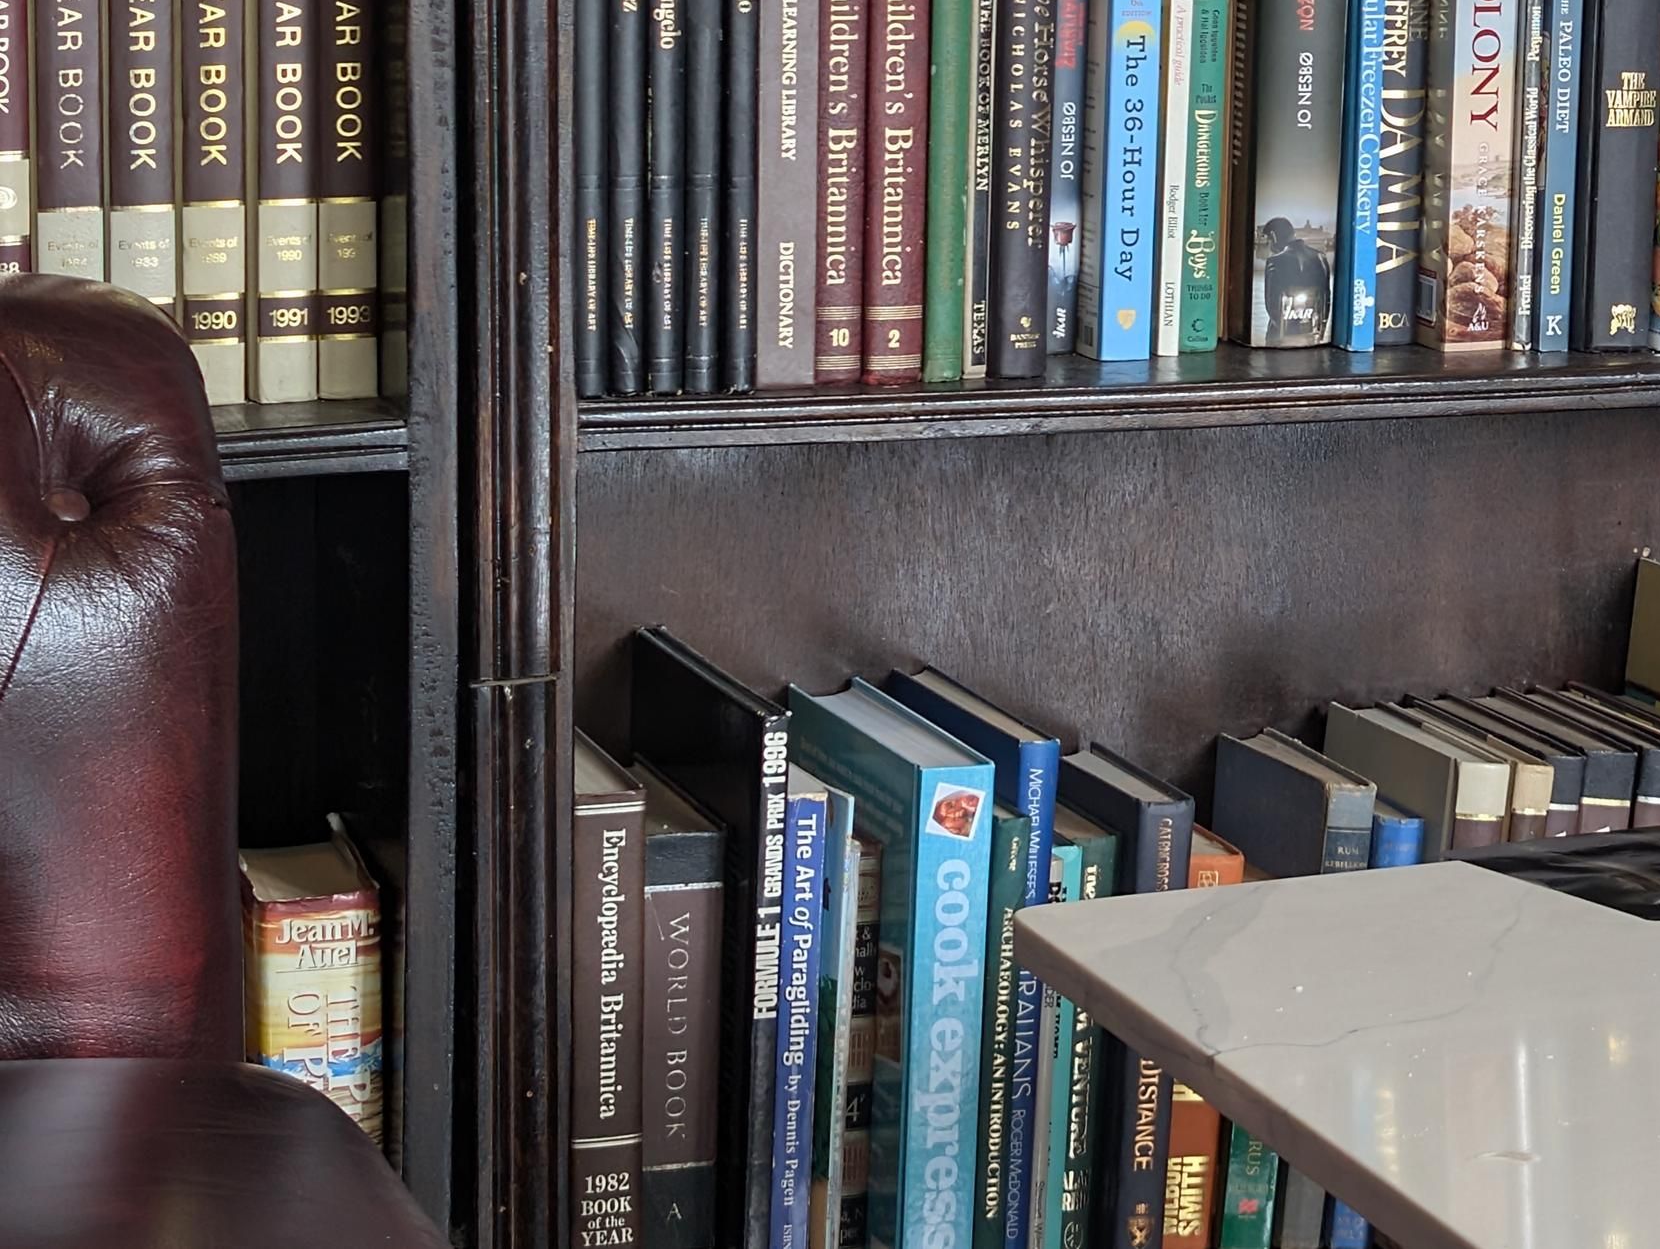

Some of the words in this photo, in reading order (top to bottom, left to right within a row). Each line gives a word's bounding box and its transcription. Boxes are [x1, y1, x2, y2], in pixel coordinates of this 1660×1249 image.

[1125, 35, 1145, 87] The
[1557, 21, 1573, 82] PALEO
[1359, 49, 1384, 134] Freezer
[1605, 90, 1656, 108] VAMPIRE
[1621, 72, 1645, 89] THE
[199, 64, 228, 166] BOOK
[780, 88, 798, 161] LIBRARY
[1061, 102, 1076, 156] NESBØ
[1556, 88, 1571, 134] DIET
[1606, 109, 1654, 127] ARMAND
[1060, 160, 1074, 181] JO
[1120, 98, 1145, 218] 36-Hour
[1376, 89, 1427, 274] DAMIA
[826, 127, 857, 285] Britannica
[1006, 147, 1023, 230] EVANS
[1166, 185, 1179, 215] Rodger
[1355, 134, 1380, 235] Cookery
[1551, 193, 1566, 243] Daniel
[1114, 228, 1140, 282] Day
[1550, 248, 1564, 294] Green
[191, 310, 237, 330] 1990
[778, 242, 794, 349] DICTIONARY
[1163, 281, 1175, 326] LOTHIAN
[829, 328, 849, 347] 10
[762, 731, 788, 787] 1996
[766, 794, 786, 829] PRIX
[795, 814, 817, 859] The
[764, 834, 784, 898] GRANDS
[794, 865, 815, 902] Art
[276, 918, 340, 944] Jean
[341, 912, 375, 938] M.
[758, 906, 781, 919] 1
[789, 908, 813, 930] of
[933, 858, 982, 1003] cook
[296, 942, 358, 970] Auel
[666, 912, 690, 1034] WORLD
[753, 922, 781, 1019] FORMULE
[783, 932, 813, 1067] Paragliding
[599, 993, 625, 1120] Britannica
[993, 1053, 1008, 1076] AN
[665, 1050, 687, 1139] BOOK
[986, 1082, 1004, 1219] INTRODUCTION
[581, 1196, 632, 1215] BOOK
[585, 1172, 630, 1194] 1982
[1178, 1156, 1209, 1237] SMITH
[581, 1227, 633, 1246] YEAR
[588, 1218, 601, 1229] of
[605, 1216, 624, 1226] the
